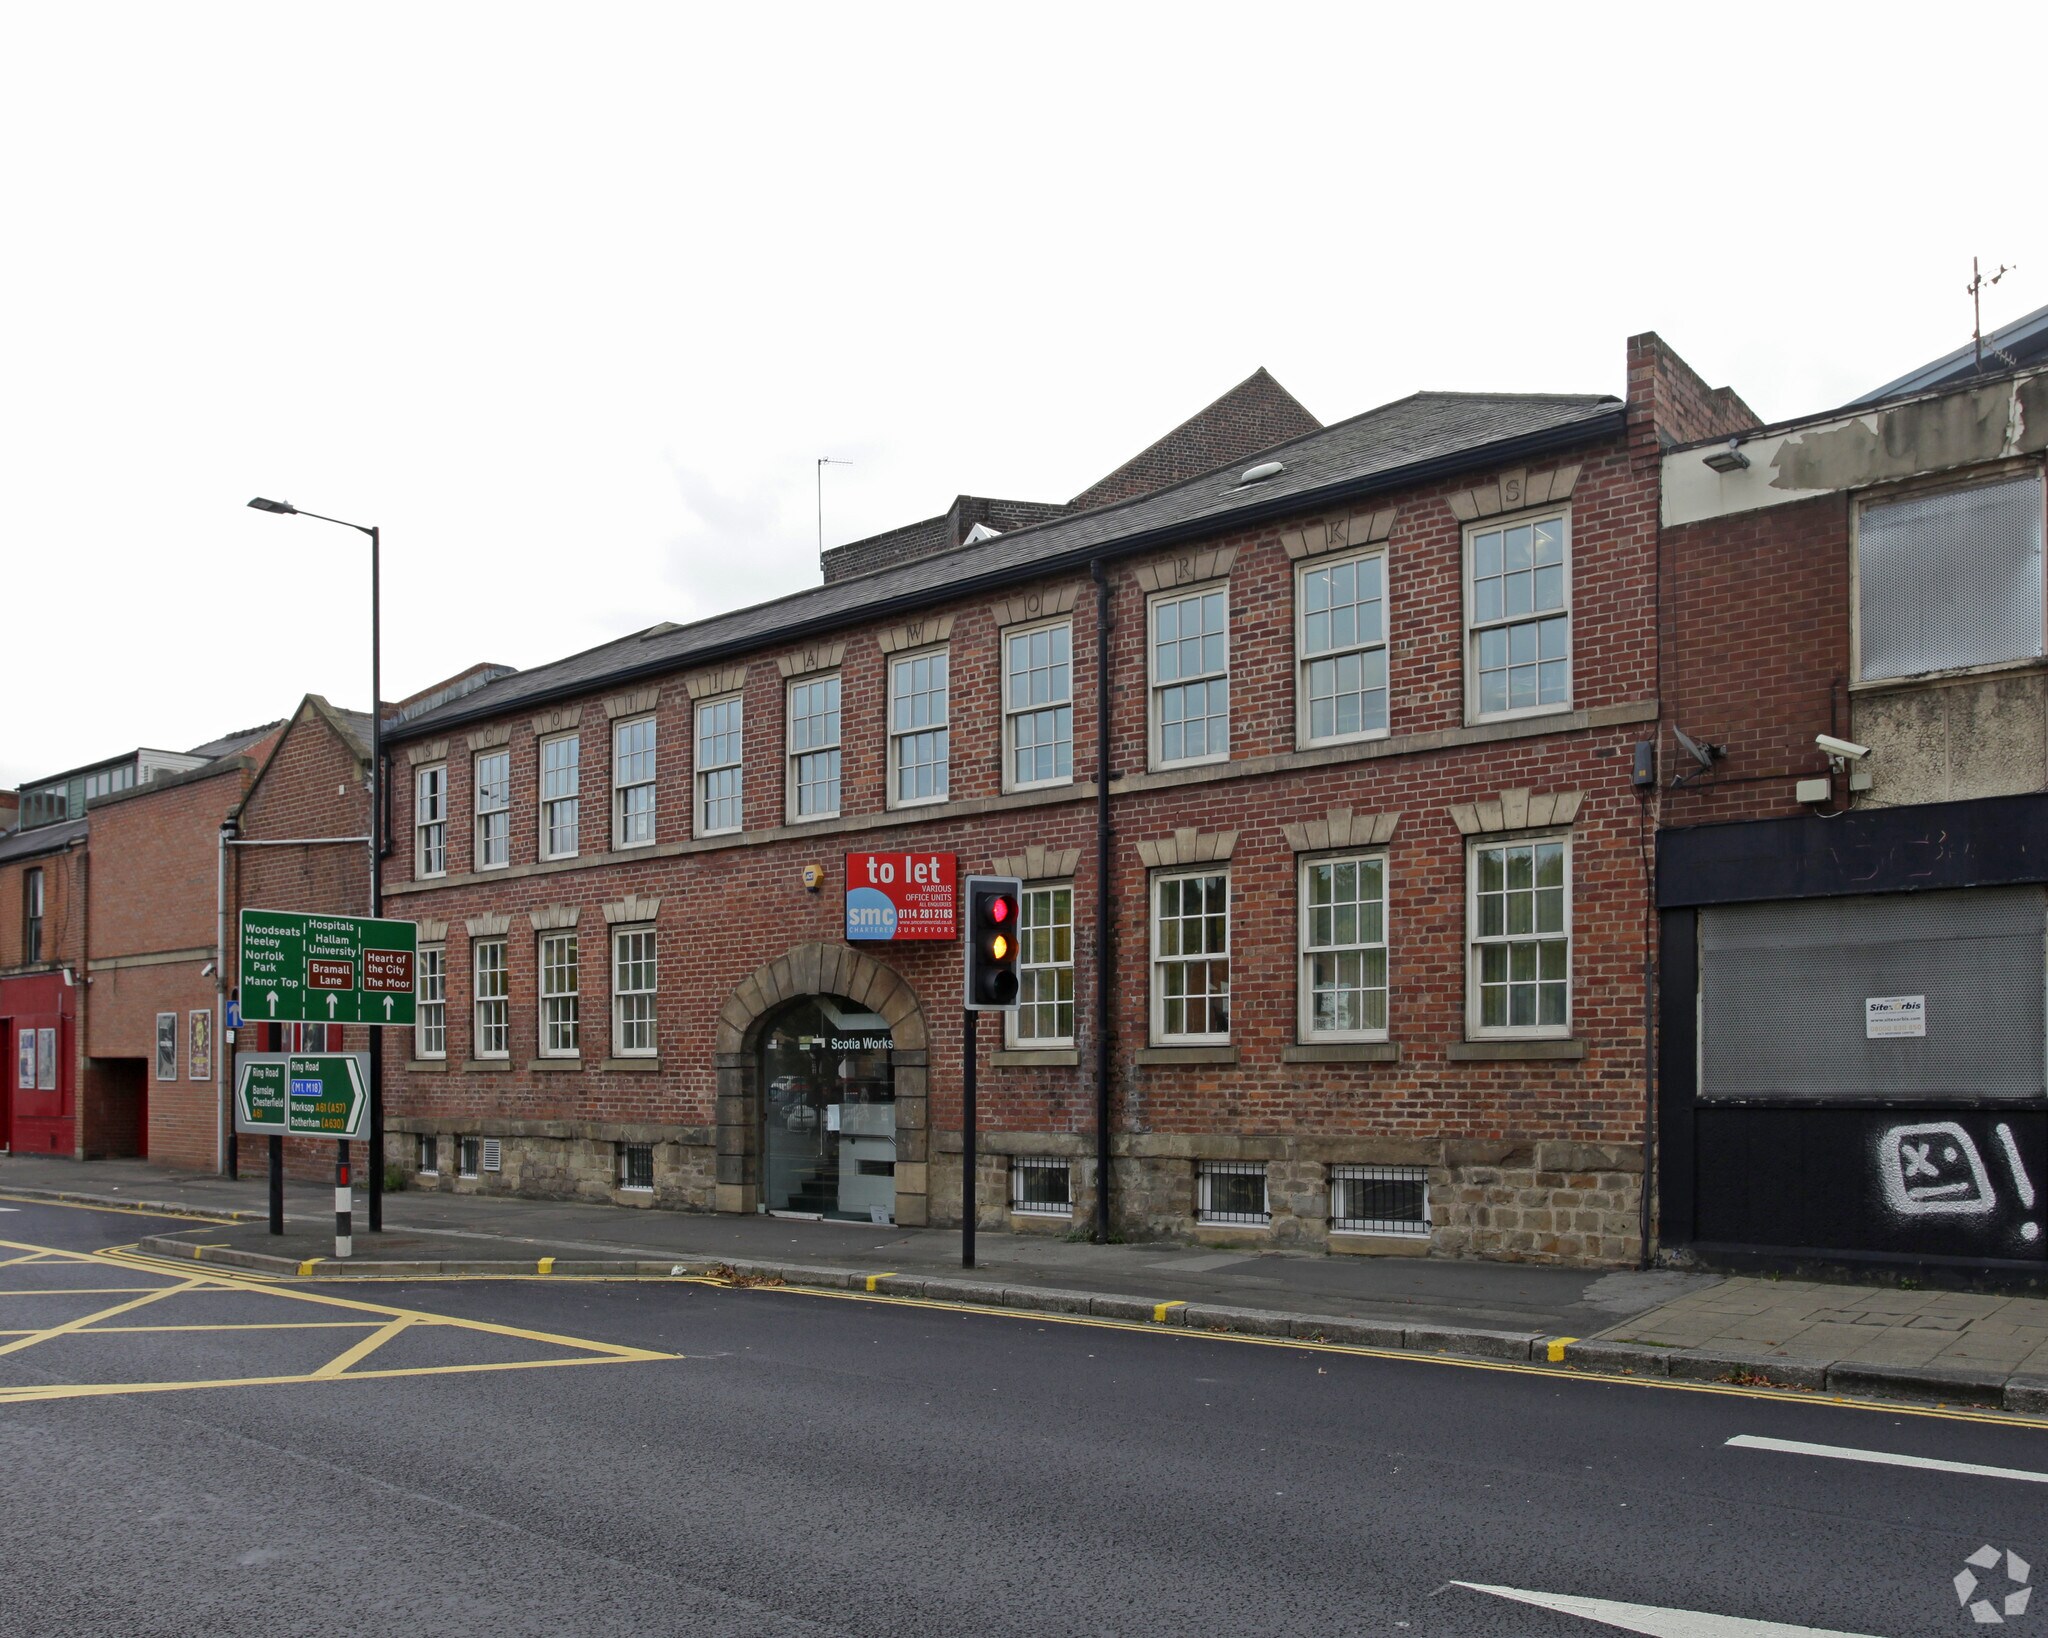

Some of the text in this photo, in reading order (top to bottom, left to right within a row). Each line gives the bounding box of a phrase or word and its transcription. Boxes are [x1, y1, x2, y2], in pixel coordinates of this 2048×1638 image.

[866, 856, 940, 884] to let
[906, 894, 952, 902] OFFICE UNITS
[848, 908, 894, 925] smc
[898, 909, 917, 918] 0114
[920, 909, 933, 918] 281
[245, 924, 300, 936] Woodseats
[309, 919, 354, 932] Hospitals
[245, 936, 280, 948] Heeley
[315, 934, 349, 945] Hallam
[245, 950, 284, 961] Norfolk
[309, 945, 356, 957] University
[367, 953, 406, 963] Heart of
[254, 962, 276, 972] Park
[312, 964, 350, 975] Bramall
[368, 964, 405, 976] the City
[245, 976, 299, 989] Manor Top
[320, 975, 342, 985] Lane
[366, 977, 410, 989] The Moor
[831, 1037, 894, 1050] Scotia Works
[291, 1062, 320, 1073] Ring Road
[252, 1068, 279, 1079] Ring Road
[252, 1085, 274, 1096] Barnsley
[306, 1081, 321, 1093] M18)
[252, 1097, 284, 1108] Chesterfield
[291, 1102, 346, 1114] Worksop A61 (A57)
[252, 1109, 263, 1118] A61
[291, 1117, 345, 1129] Rotherham (A630)
